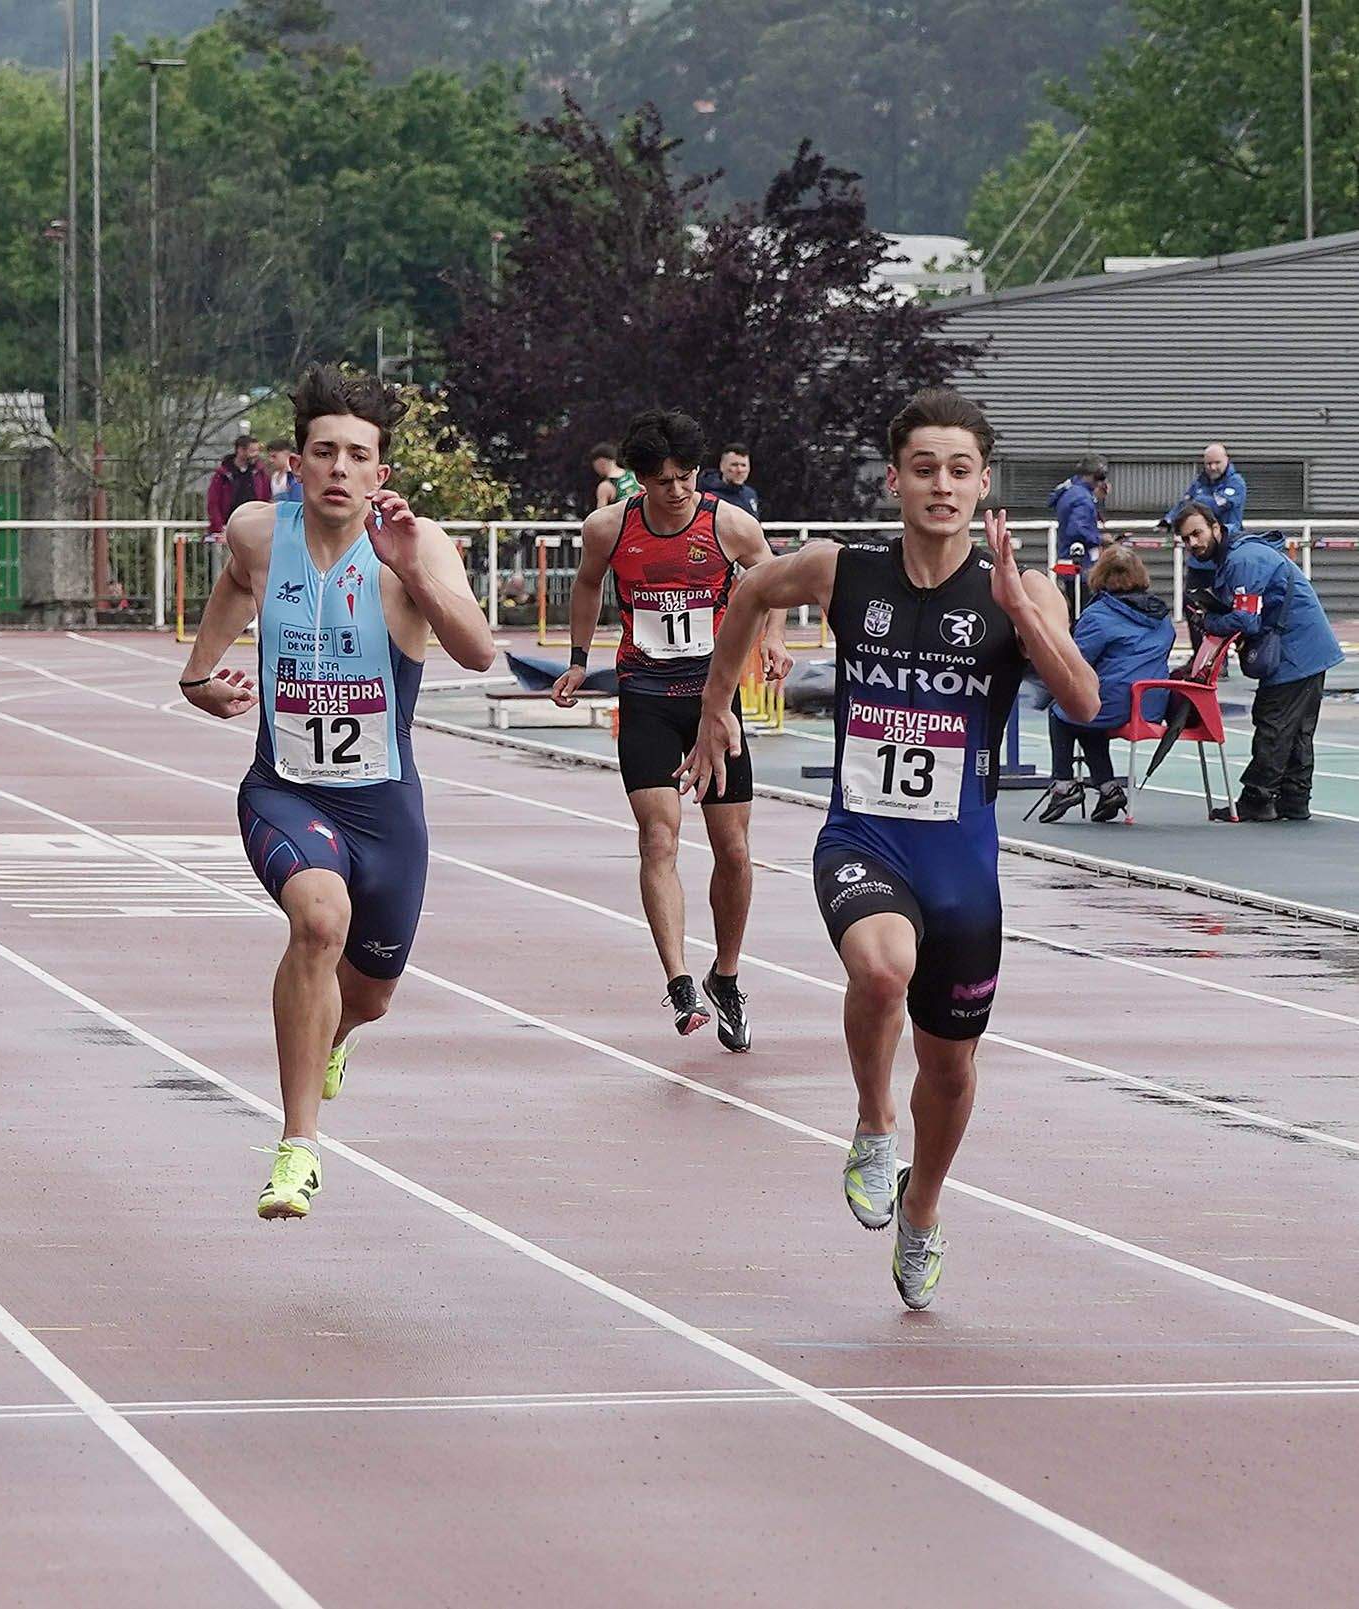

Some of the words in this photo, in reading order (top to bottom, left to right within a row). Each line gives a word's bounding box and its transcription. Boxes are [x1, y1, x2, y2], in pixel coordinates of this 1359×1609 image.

[633, 589, 713, 603] PONTEVEDRA
[659, 600, 687, 612] 2025
[661, 611, 691, 645] 11
[856, 643, 890, 656] CLUB
[844, 658, 993, 697] NARÓN
[277, 681, 384, 700] PONTEVEDRA
[308, 700, 349, 714] 2025
[851, 703, 966, 733] PONTEVEDRA
[305, 717, 361, 764] 12
[883, 726, 926, 744] 2025
[877, 744, 936, 798] 13
